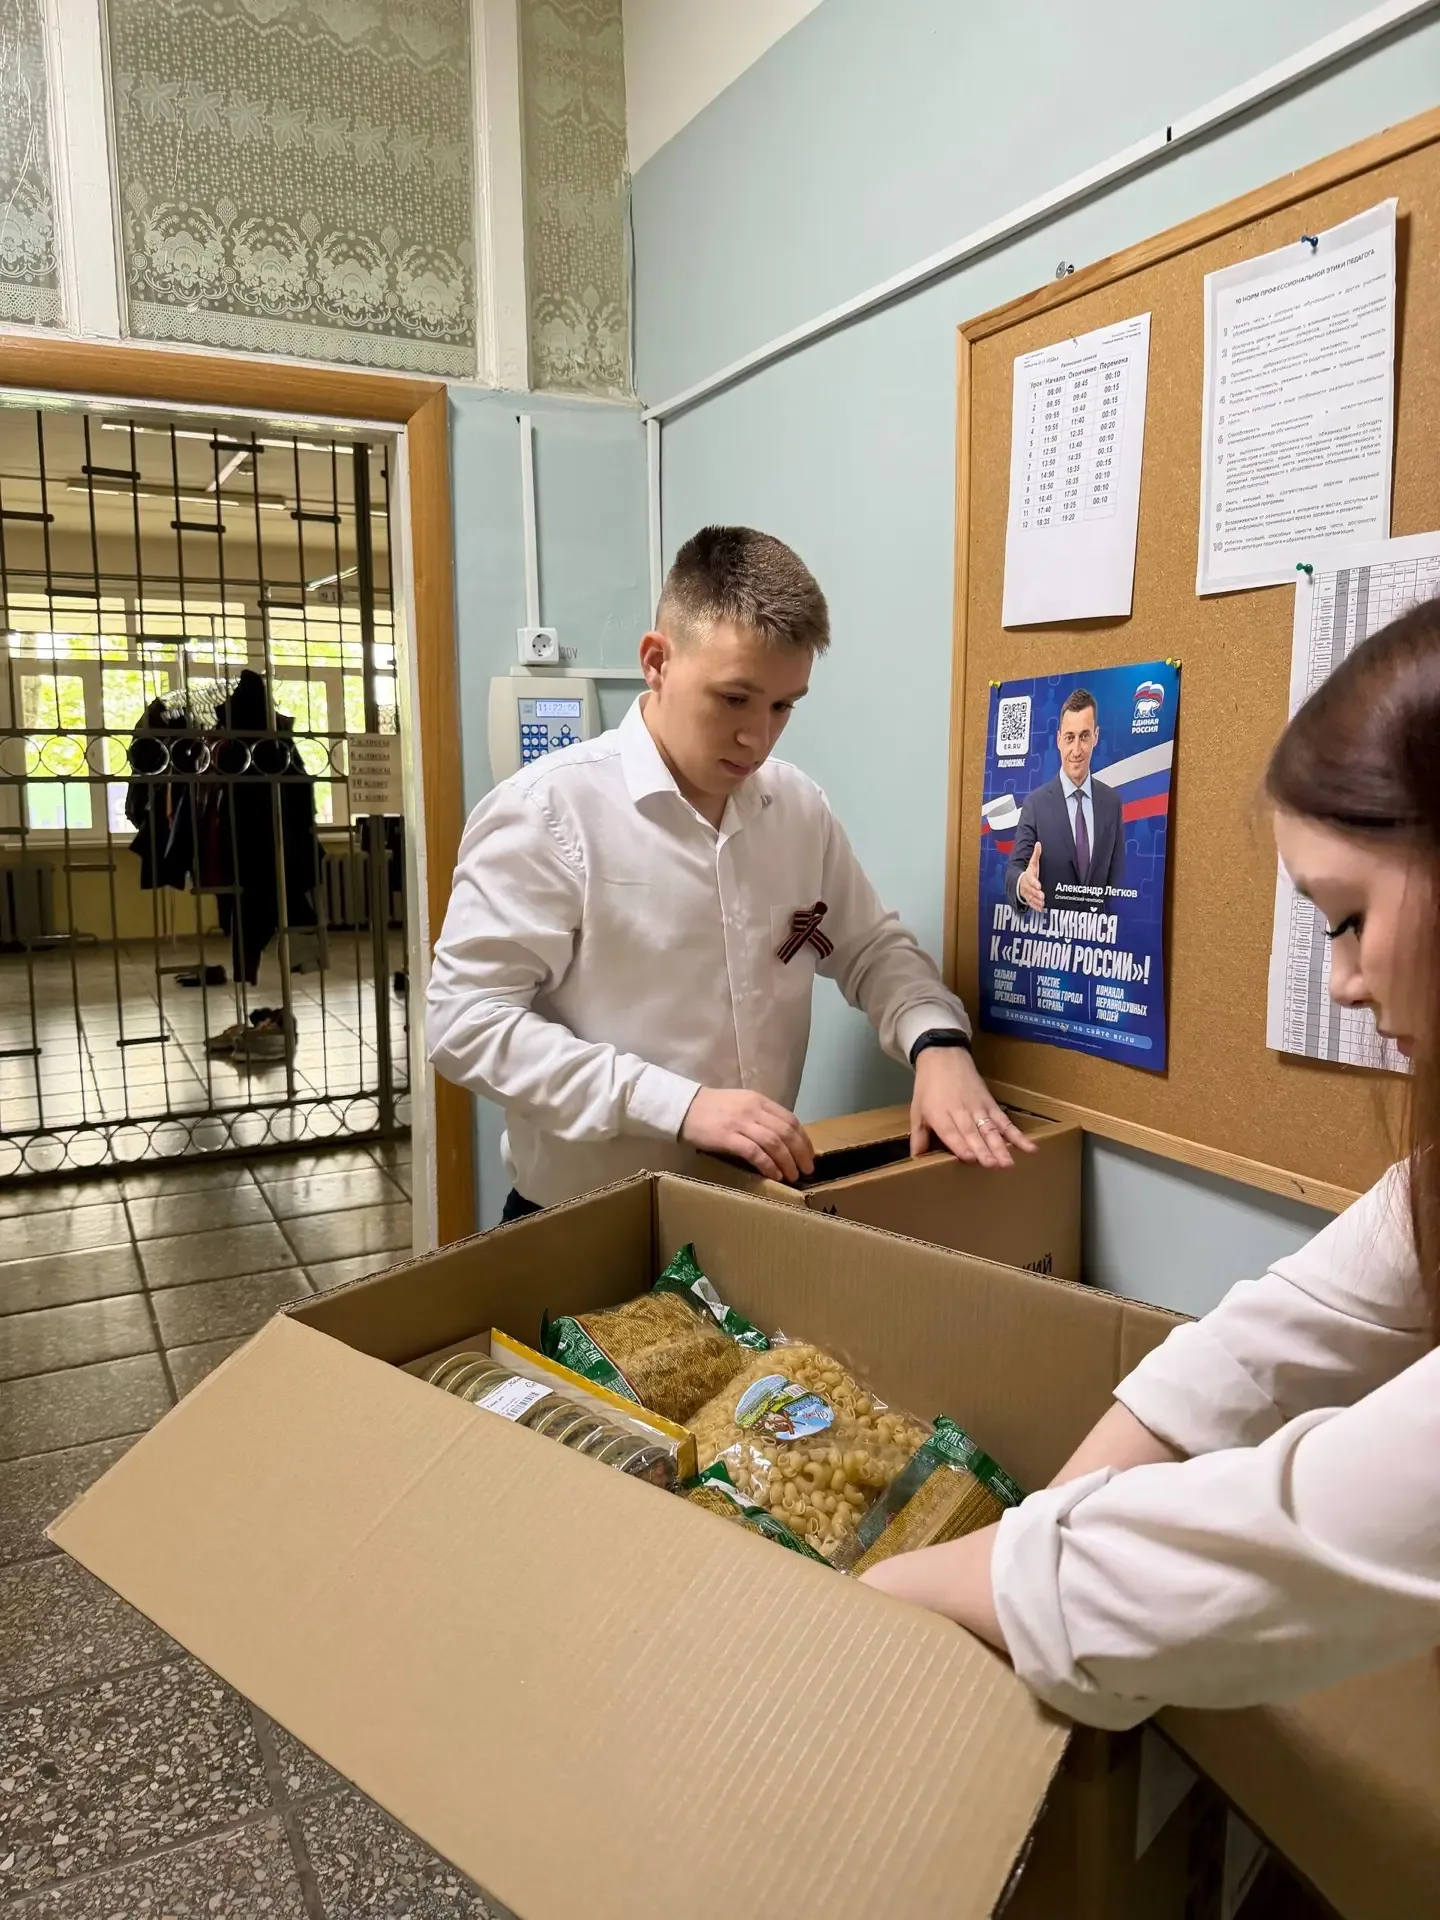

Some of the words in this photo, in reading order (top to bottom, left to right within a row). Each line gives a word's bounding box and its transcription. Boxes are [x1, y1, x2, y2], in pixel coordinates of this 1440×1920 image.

[1242, 292, 1259, 302] НОРМ
[1260, 268, 1326, 300] ПРОФЕССИОНАЛЬНОЙ
[1326, 261, 1346, 274] ЭТИКИ
[1346, 249, 1375, 267] ПЕДАГОГА
[1030, 380, 1042, 390] Урок
[1044, 374, 1066, 385] Начало
[1068, 366, 1098, 380] Окончание
[1099, 356, 1128, 370] Перемена
[1132, 718, 1159, 726] ЕДИНАЯ
[1132, 726, 1158, 734] РОССИЯ
[1055, 882, 1104, 897] Александр
[1104, 886, 1138, 898] Легков
[993, 904, 1118, 944] ПРИСОЕДИНЯЙСЯ
[990, 935, 1001, 961] К
[1002, 938, 1072, 972] «ЕДИНОЙ
[1072, 946, 1150, 984] РОССИИ»!
[994, 968, 1017, 981] СИЛЬНАЯ
[1036, 975, 1061, 988] УЧАСТИЕ
[994, 991, 1026, 1004] ПРЕЗИДЕНТА
[1037, 987, 1041, 997] В
[1041, 988, 1060, 1000] ЖИЗНИ
[1061, 991, 1083, 1004] ГОРОДА
[1096, 985, 1124, 999] КОМАНДА
[1037, 998, 1042, 1008] И
[1042, 1000, 1064, 1013] СТРАНЫ
[1096, 996, 1148, 1016] НЕРАВНОДУШНЫХ
[1096, 1008, 1119, 1022] ЛЮДЕЙ
[1005, 1010, 1039, 1023] Заполни
[1086, 1027, 1110, 1038] сайте
[1114, 1033, 1135, 1044] er.ru
